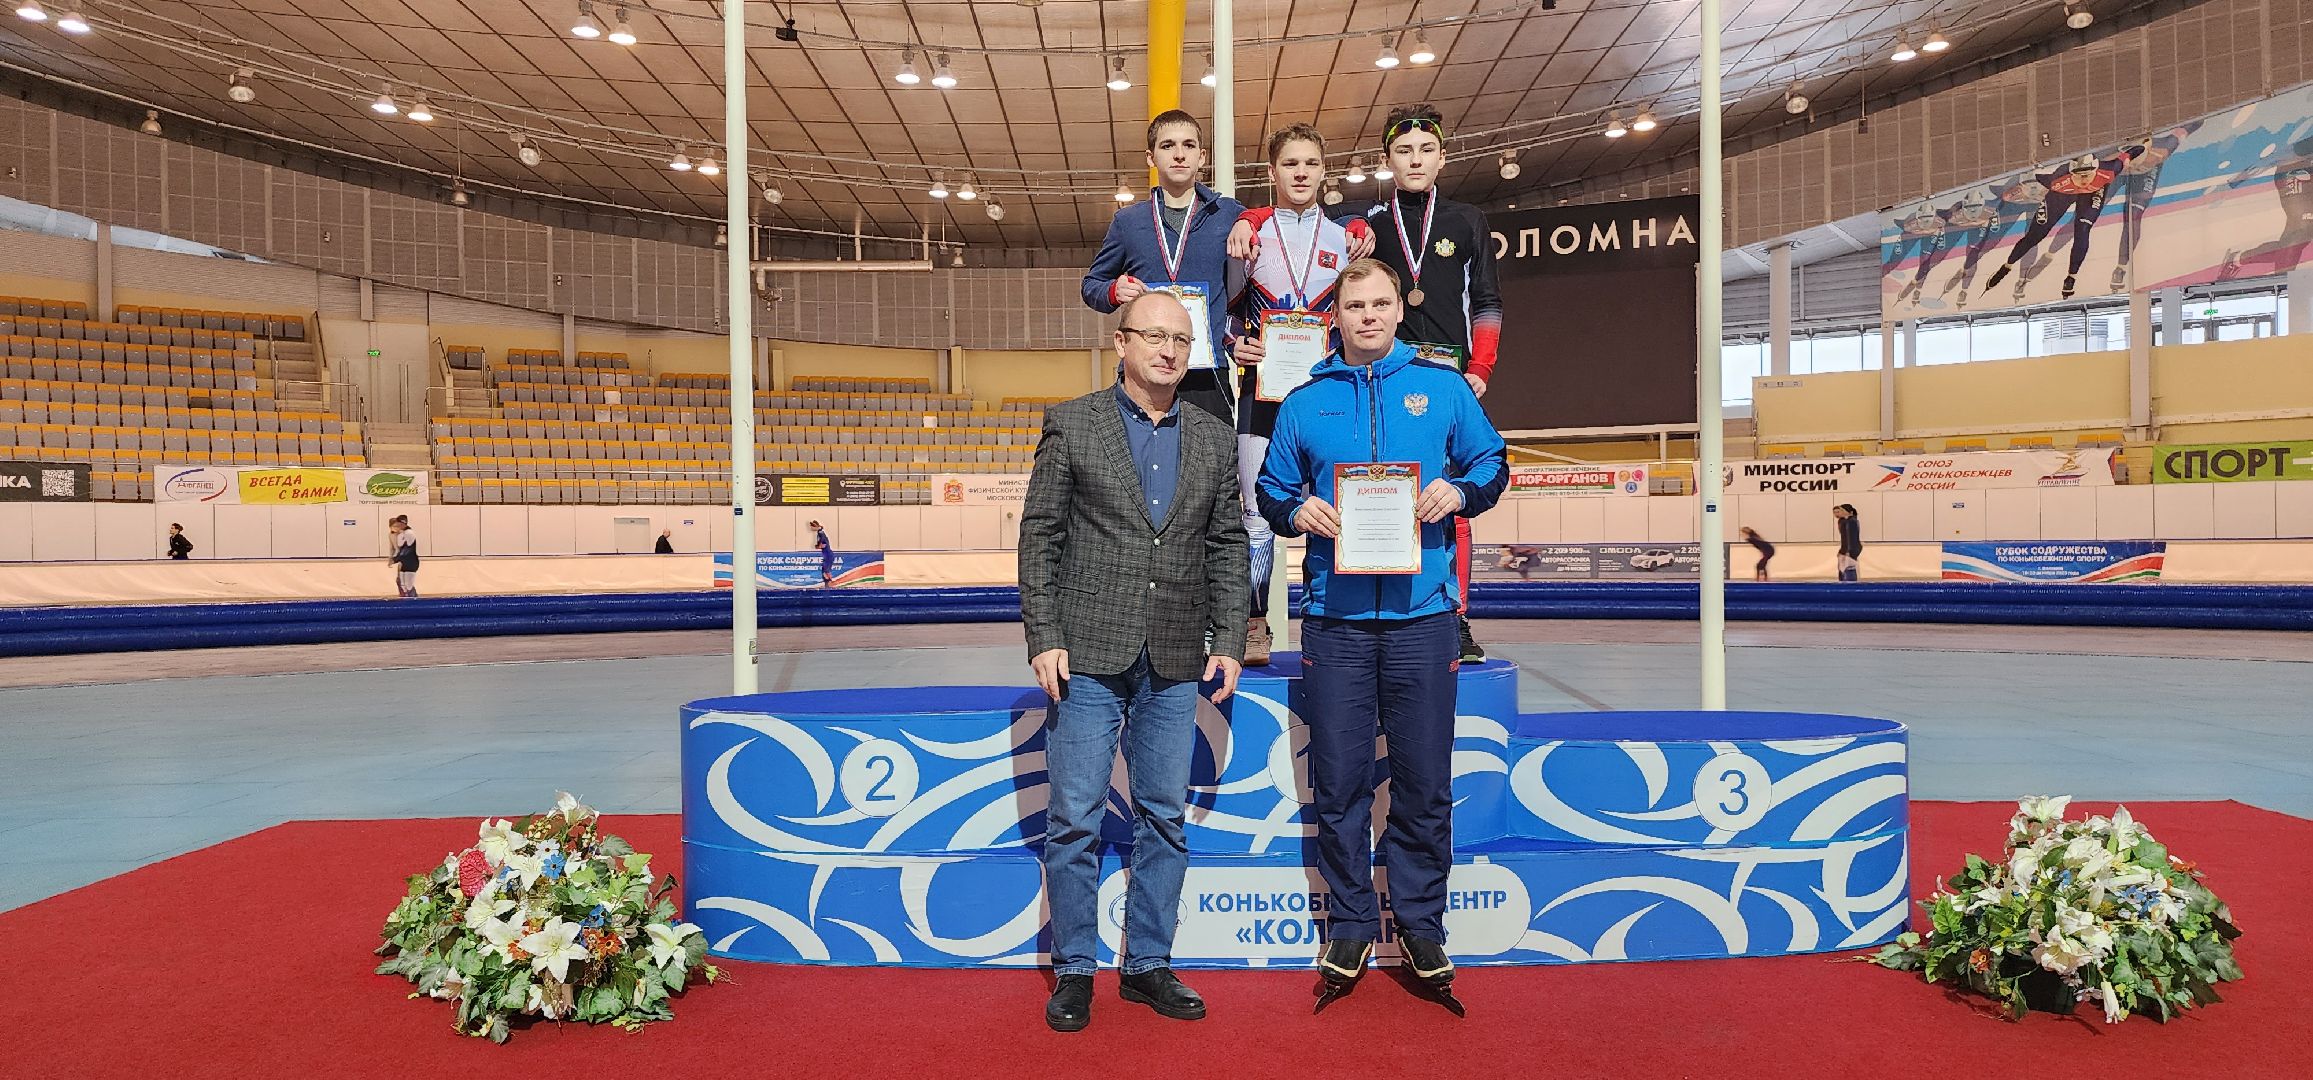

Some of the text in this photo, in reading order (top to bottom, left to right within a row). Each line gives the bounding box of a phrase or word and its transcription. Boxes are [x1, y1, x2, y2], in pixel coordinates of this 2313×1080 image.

[1744, 463, 1855, 476] МИНСПОРТ
[1917, 460, 1953, 468] СОЮЗ
[2164, 448, 2290, 478] СПОРТ
[1516, 474, 1609, 485] ЛОР-ОРГАНОВ
[1912, 468, 2012, 479] КОНЬКОБЕЖЦЕВ
[249, 474, 302, 487] ВСЕГДА
[1760, 479, 1838, 492] РОССИИ
[1907, 482, 1955, 490] РОССИИ
[279, 486, 338, 500] С ВАМИ!
[1357, 487, 1398, 496] ДИПЛОМ
[1995, 546, 2107, 556] КУБОК СОДРУЖЕСТВА
[757, 557, 784, 565] КУБОК
[1296, 741, 1314, 789] 1
[865, 755, 896, 802] 2
[1718, 770, 1749, 816] 3
[1445, 890, 1507, 913] ЕНТР
